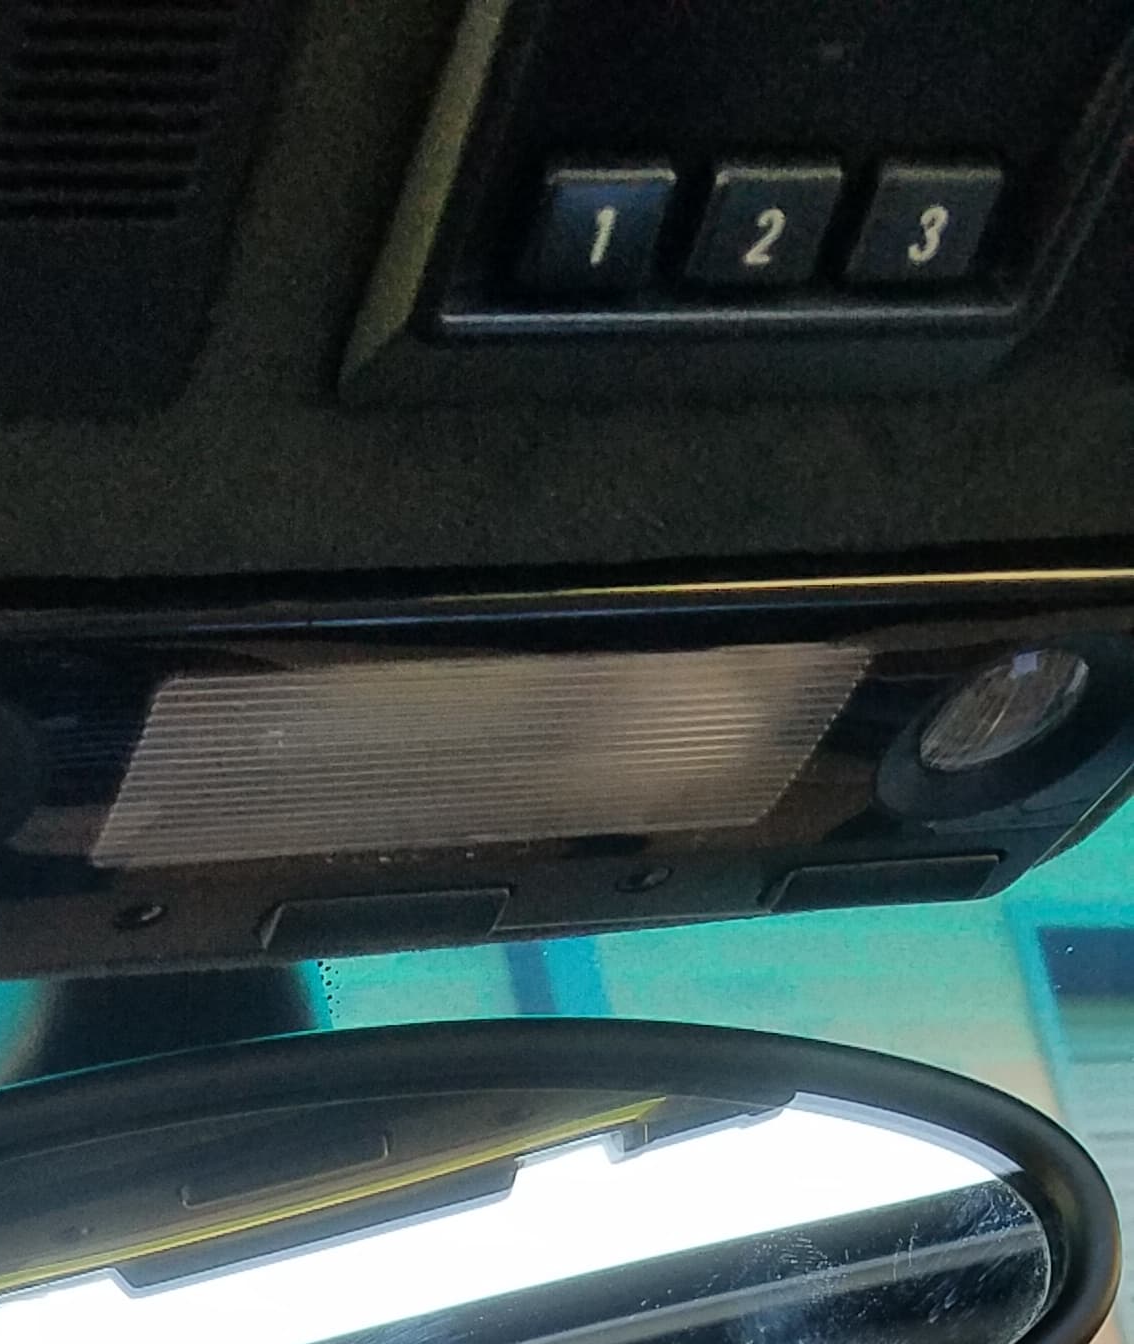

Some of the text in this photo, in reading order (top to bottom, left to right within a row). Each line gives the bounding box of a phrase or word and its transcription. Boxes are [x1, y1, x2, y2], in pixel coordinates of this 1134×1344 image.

[590, 205, 948, 265] 1 2 3
